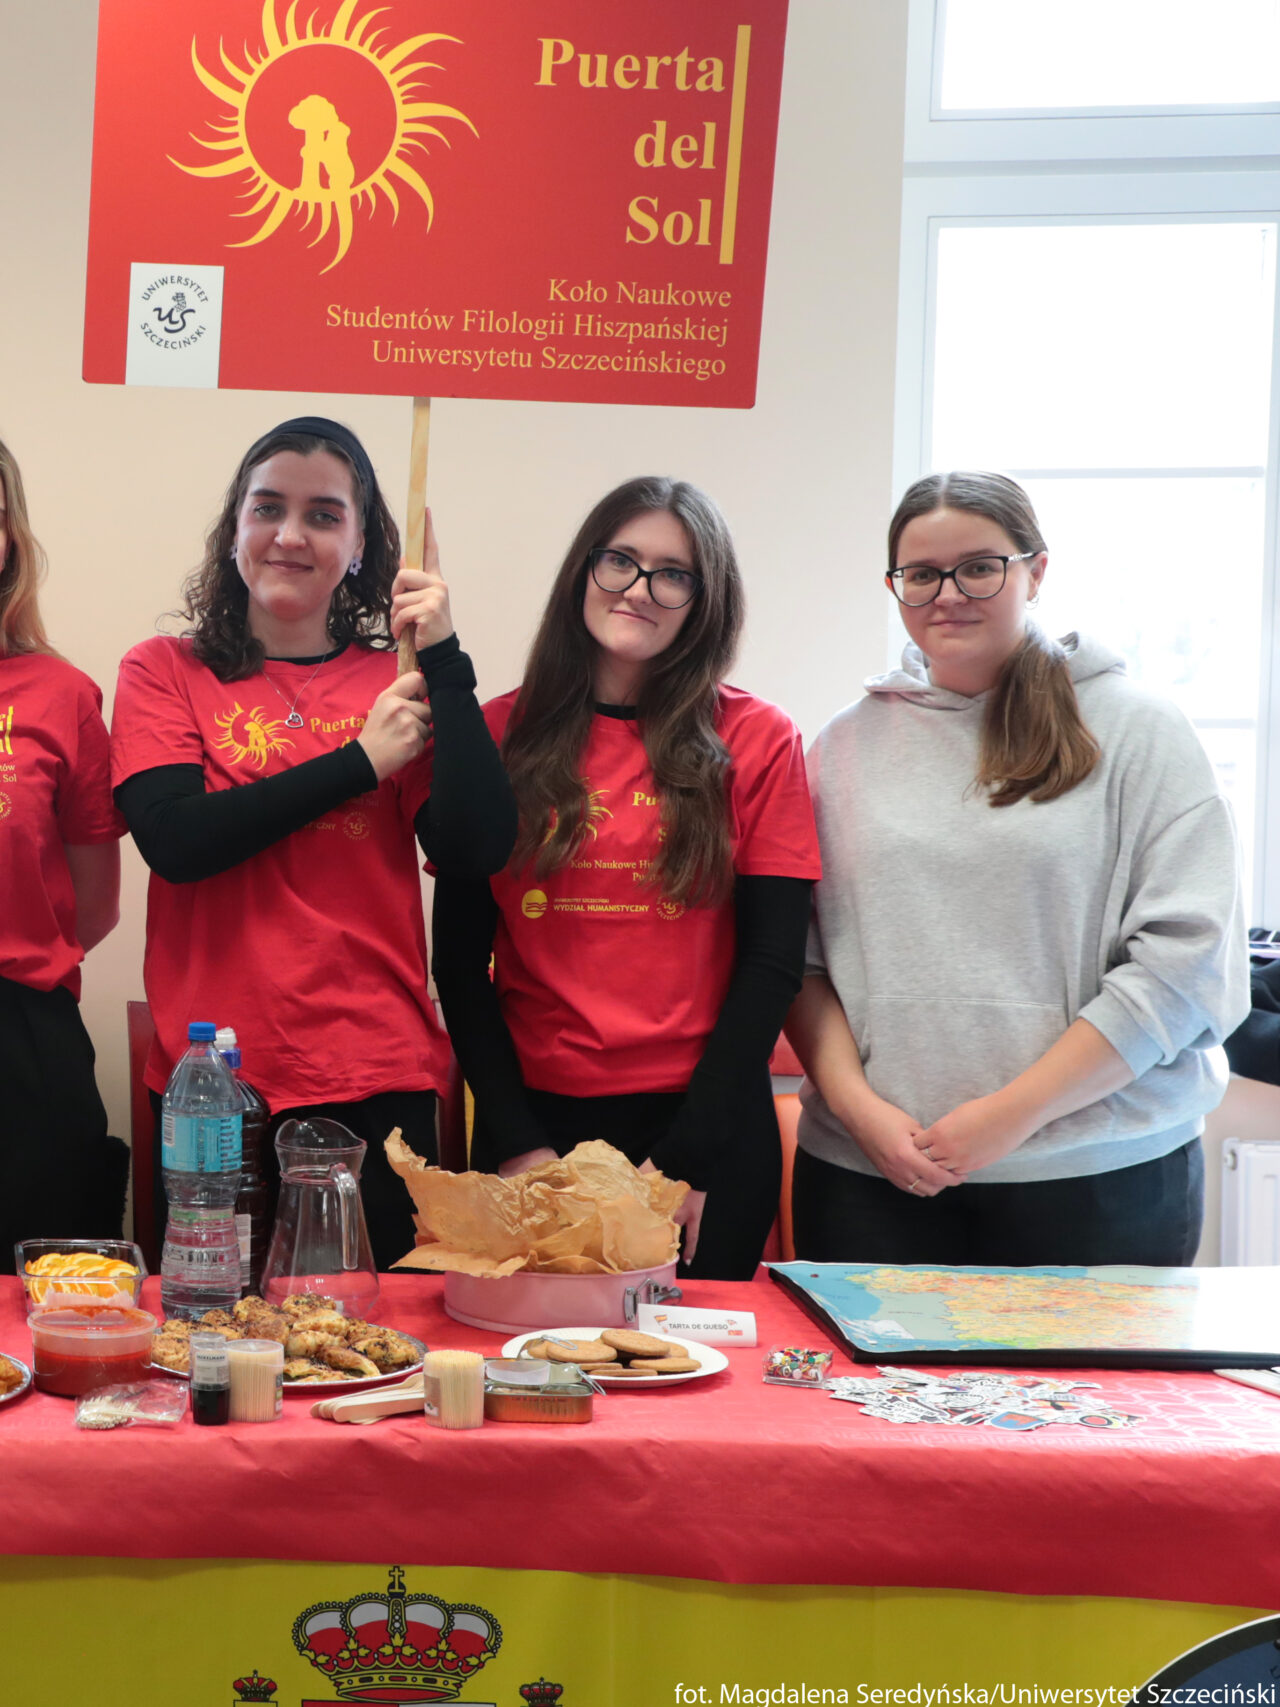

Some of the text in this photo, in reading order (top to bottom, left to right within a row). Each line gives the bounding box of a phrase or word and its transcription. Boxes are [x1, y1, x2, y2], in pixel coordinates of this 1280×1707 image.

[534, 37, 726, 93] Puerta
[633, 119, 717, 169] del
[625, 195, 712, 246] Sol
[141, 275, 209, 304] UNIWERSYTET
[548, 278, 732, 307] Koło Naukowe
[140, 321, 207, 350] SZCZECIŃSKI
[326, 304, 729, 348] Studentów Filologii Hiszpańskiej
[372, 340, 727, 381] Uniwersytetu Szczecińskiego
[3, 773, 17, 783] Sol
[594, 860, 637, 869] Naukowe
[587, 904, 650, 913] HUMANISTYCZNY
[703, 1323, 729, 1331] QUESO
